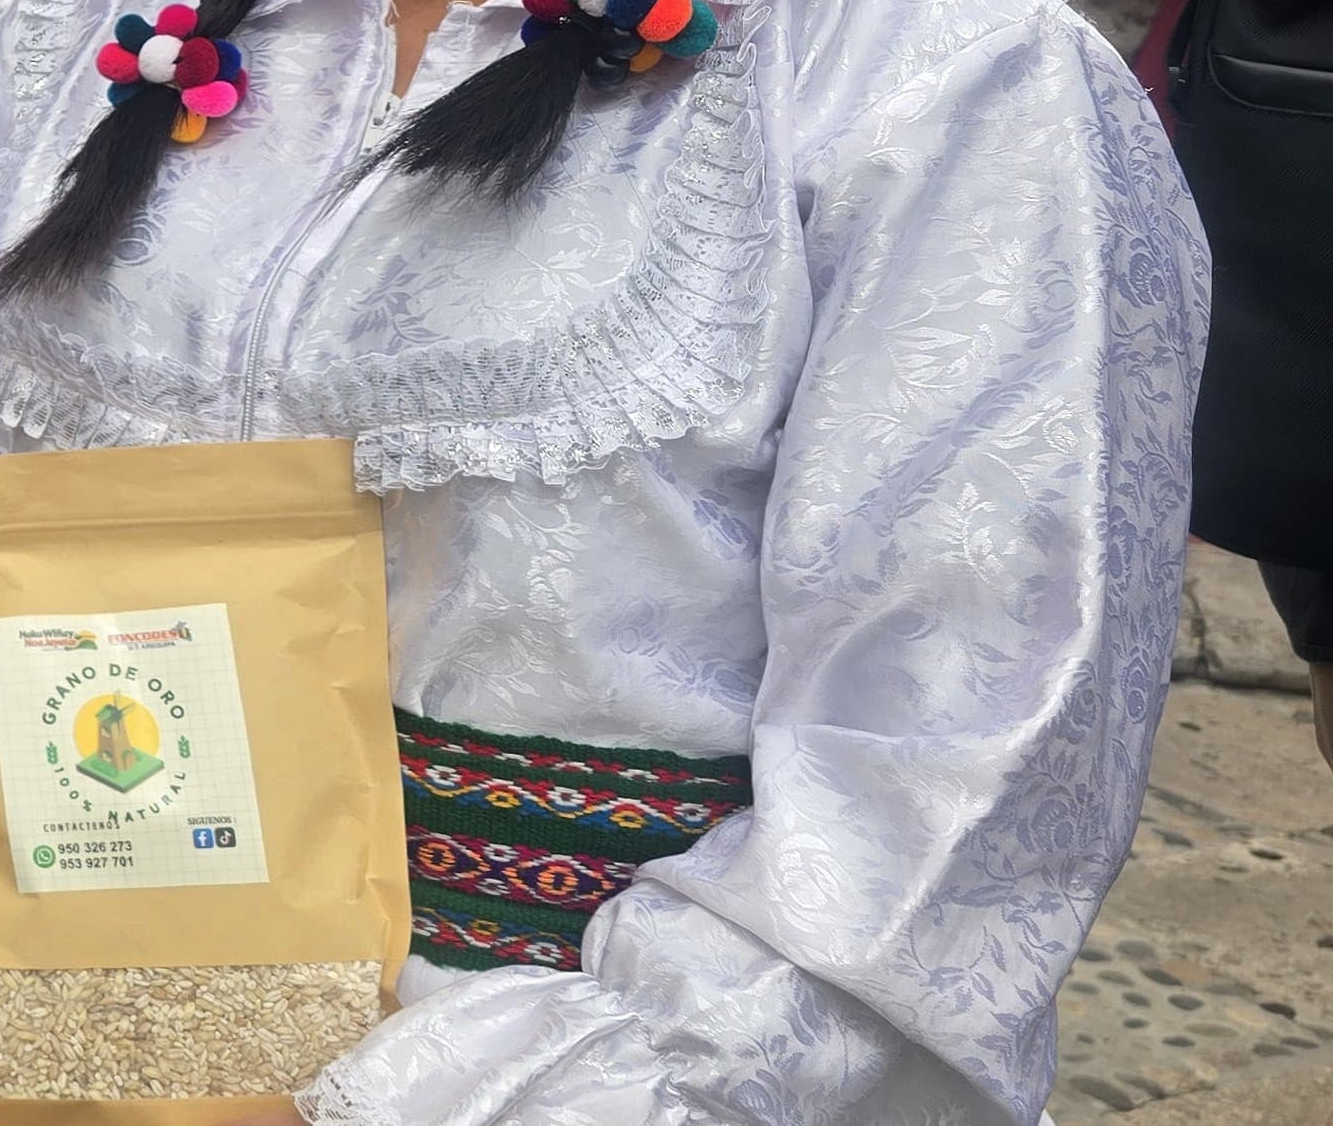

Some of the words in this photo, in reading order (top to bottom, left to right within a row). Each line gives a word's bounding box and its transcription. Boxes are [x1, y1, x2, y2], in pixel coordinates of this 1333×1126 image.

[42, 665, 96, 725] GRANO
[109, 663, 139, 681] DE
[147, 677, 185, 720] ORO
[108, 772, 187, 823] NATURAL
[42, 820, 122, 833] CONTACTENOS
[57, 841, 81, 855] 950
[84, 841, 107, 854] 326
[109, 840, 133, 853] 273
[59, 857, 83, 870] 953
[86, 856, 108, 869] 927
[112, 856, 134, 868] 701
